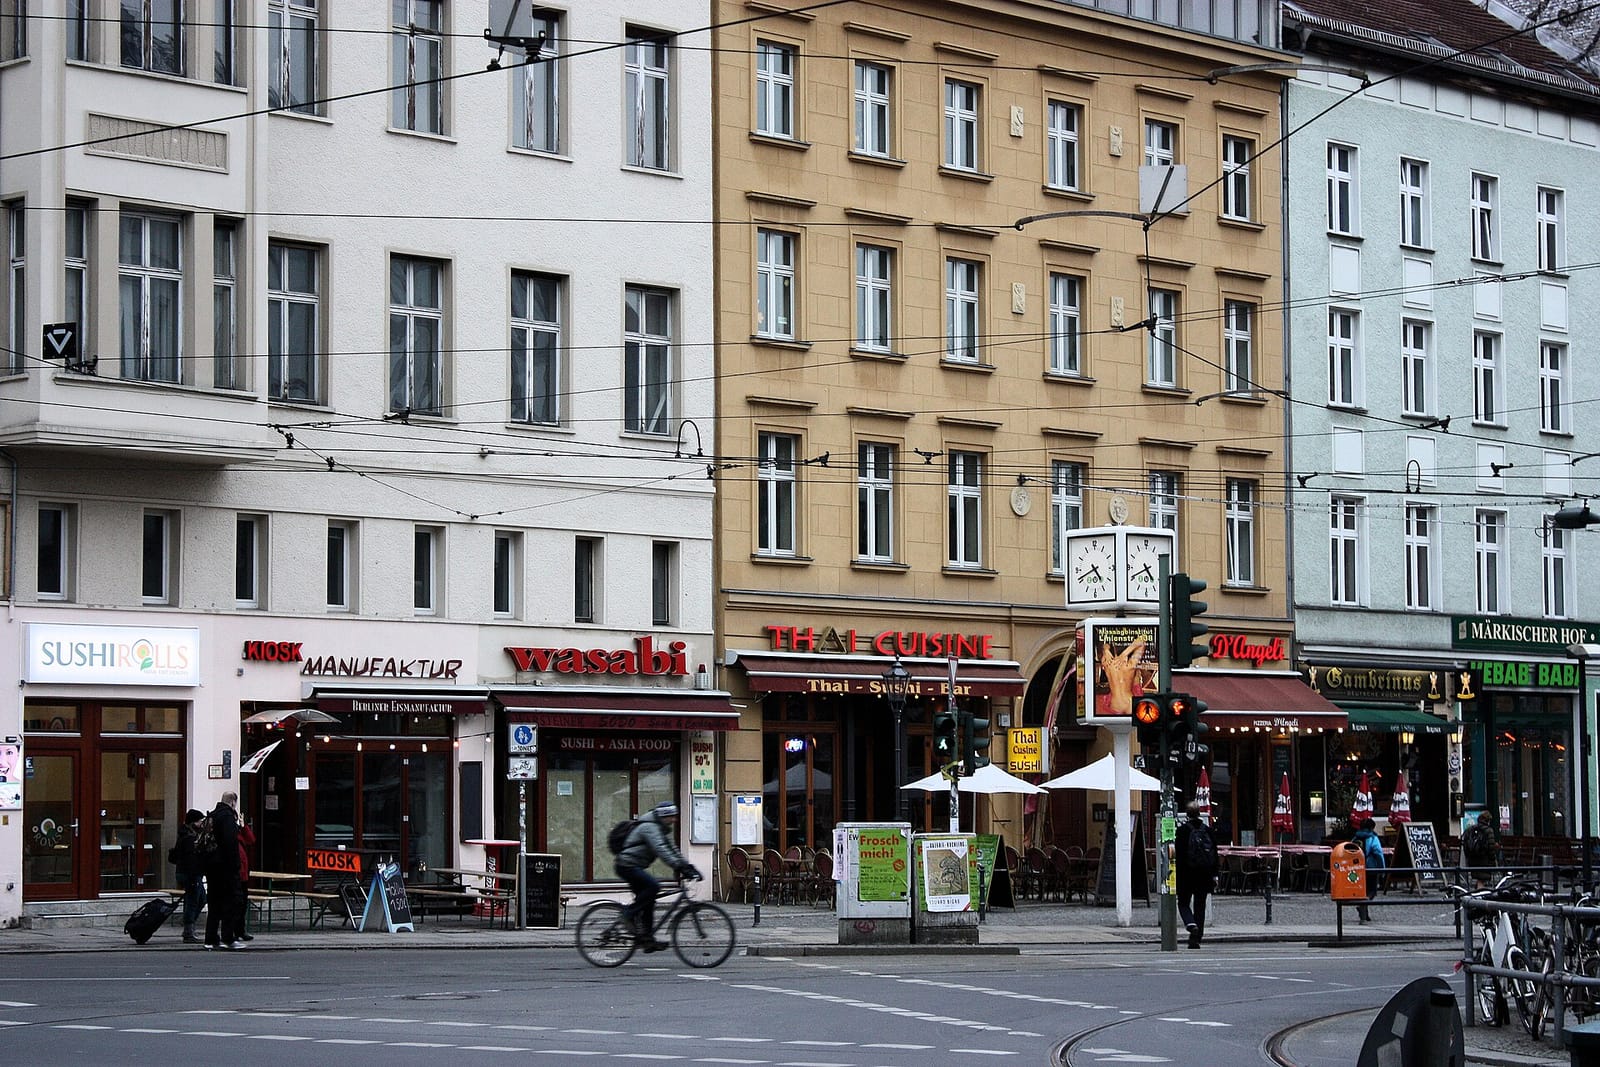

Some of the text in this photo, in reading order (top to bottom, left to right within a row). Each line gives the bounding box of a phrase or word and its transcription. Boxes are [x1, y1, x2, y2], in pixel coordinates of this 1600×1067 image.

[1471, 619, 1587, 644] MÄRKISCHER HOF
[243, 640, 303, 662] KIOSK
[765, 625, 993, 659] THAI CUISINE
[1209, 633, 1286, 668] D'Angeli
[504, 635, 690, 676] wasabi
[302, 655, 463, 679] MANUFAKTUR
[806, 679, 850, 693] Thai
[1326, 666, 1422, 691] Gambrinus
[560, 737, 671, 750] SUSHI ASIA FOOD
[1013, 730, 1038, 744] Thai
[695, 755, 711, 766] 50%
[1010, 760, 1041, 771] SUSHI
[859, 834, 899, 846] Frosch
[312, 852, 356, 870] KIOSK
[860, 847, 894, 858] mich!
